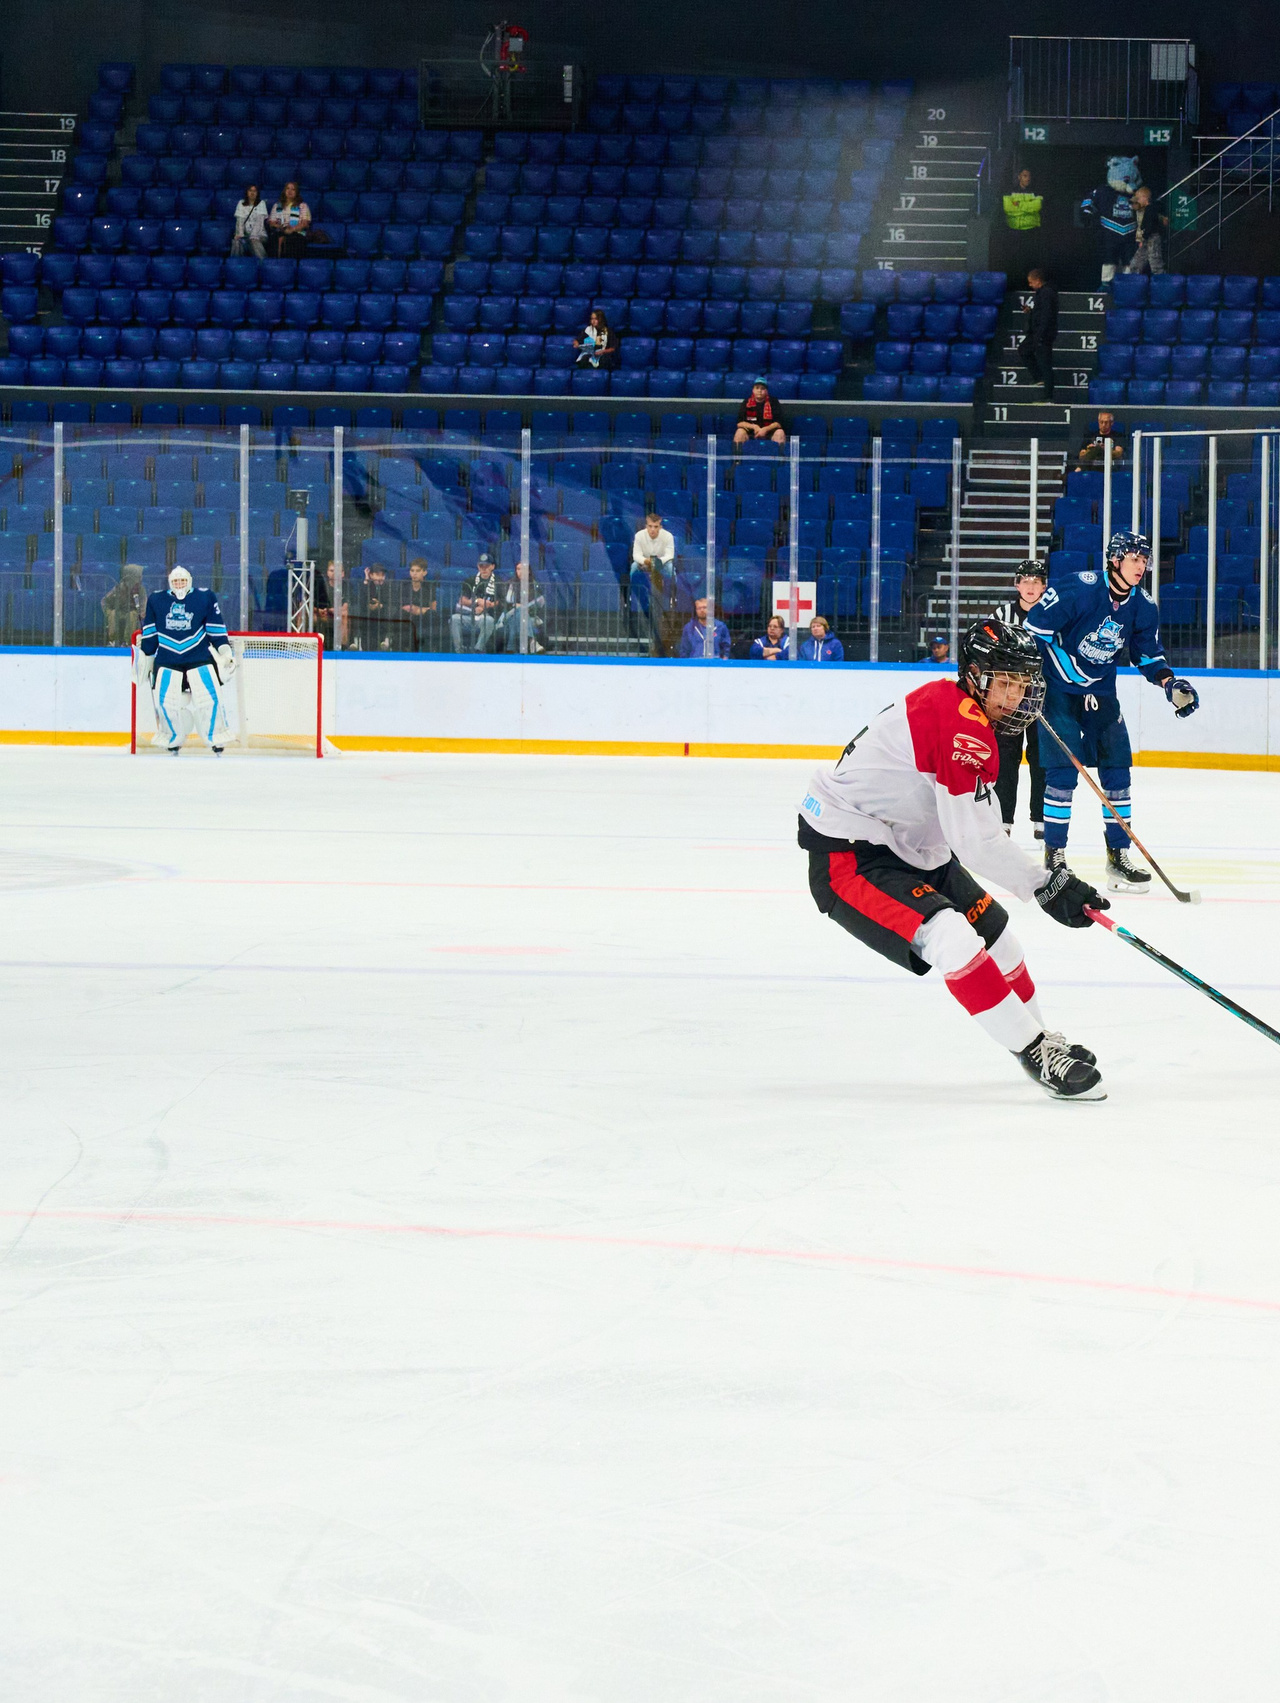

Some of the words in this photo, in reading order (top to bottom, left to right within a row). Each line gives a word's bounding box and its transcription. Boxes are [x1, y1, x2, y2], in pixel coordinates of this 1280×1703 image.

[927, 108, 946, 120] 20
[59, 118, 76, 130] 19
[922, 135, 939, 147] 19
[1024, 128, 1046, 141] H2
[1149, 129, 1171, 142] H3
[50, 149, 67, 162] 18
[912, 165, 928, 180] 18
[44, 180, 60, 192] 17
[900, 196, 916, 210] 17
[35, 213, 52, 227] 16
[888, 228, 906, 241] 16
[1019, 296, 1035, 309] 14
[1088, 297, 1105, 311] 14
[1080, 335, 1098, 349] 13
[1001, 371, 1018, 385] 12
[1072, 372, 1088, 386] 12
[993, 407, 1008, 421] 11
